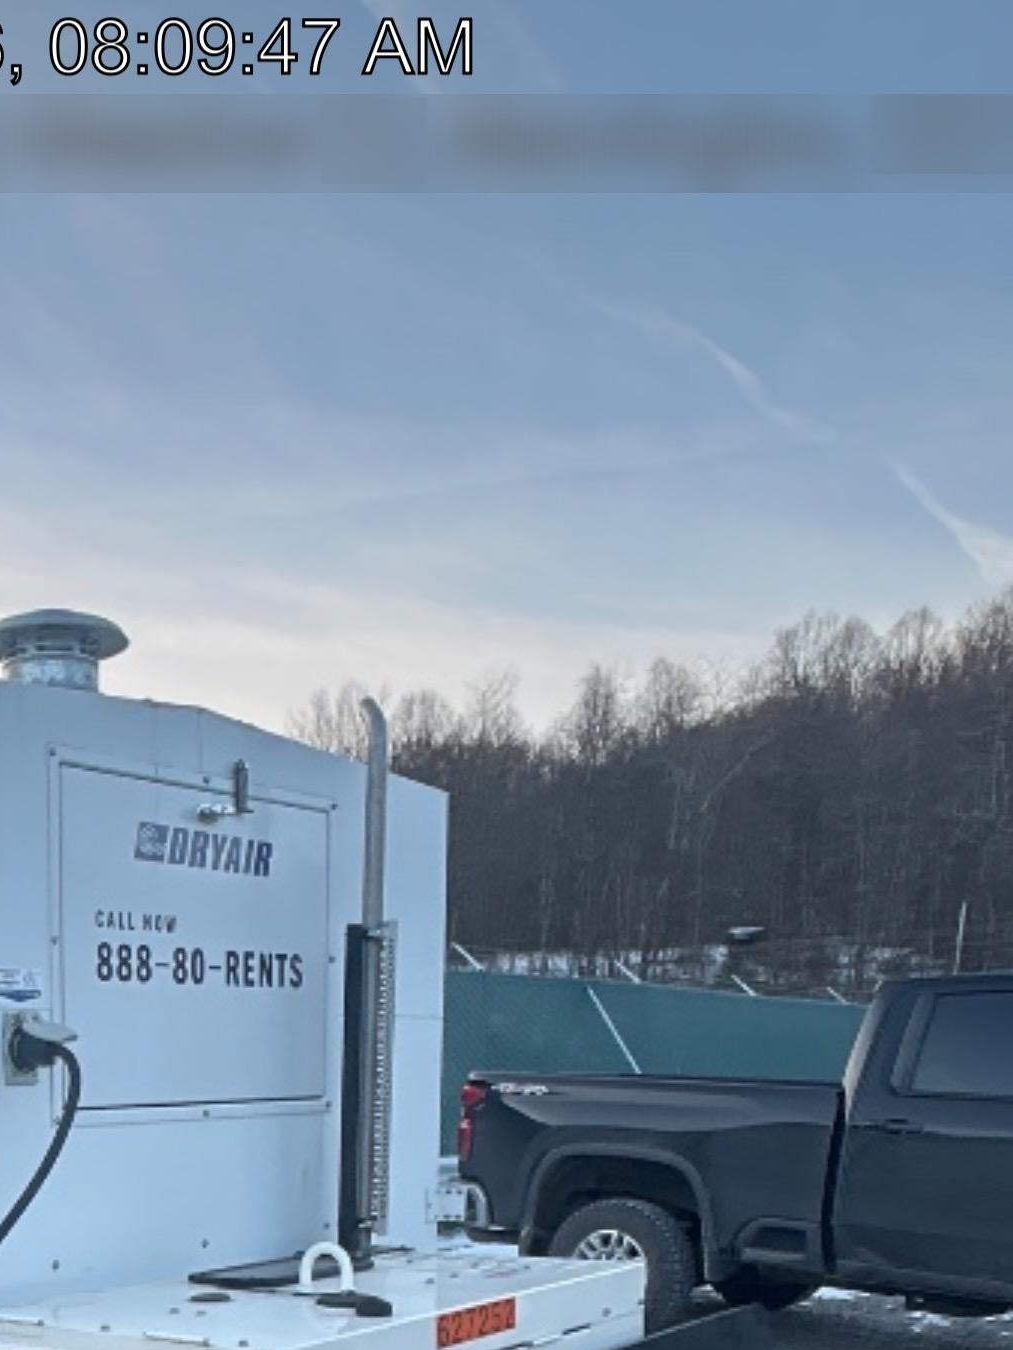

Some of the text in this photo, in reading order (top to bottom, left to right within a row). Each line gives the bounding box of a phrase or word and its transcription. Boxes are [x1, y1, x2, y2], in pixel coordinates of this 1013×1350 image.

[167, 827, 273, 877] DRYAIR
[95, 908, 177, 934] CALL NOW
[97, 942, 304, 988] 888-80-RENTS
